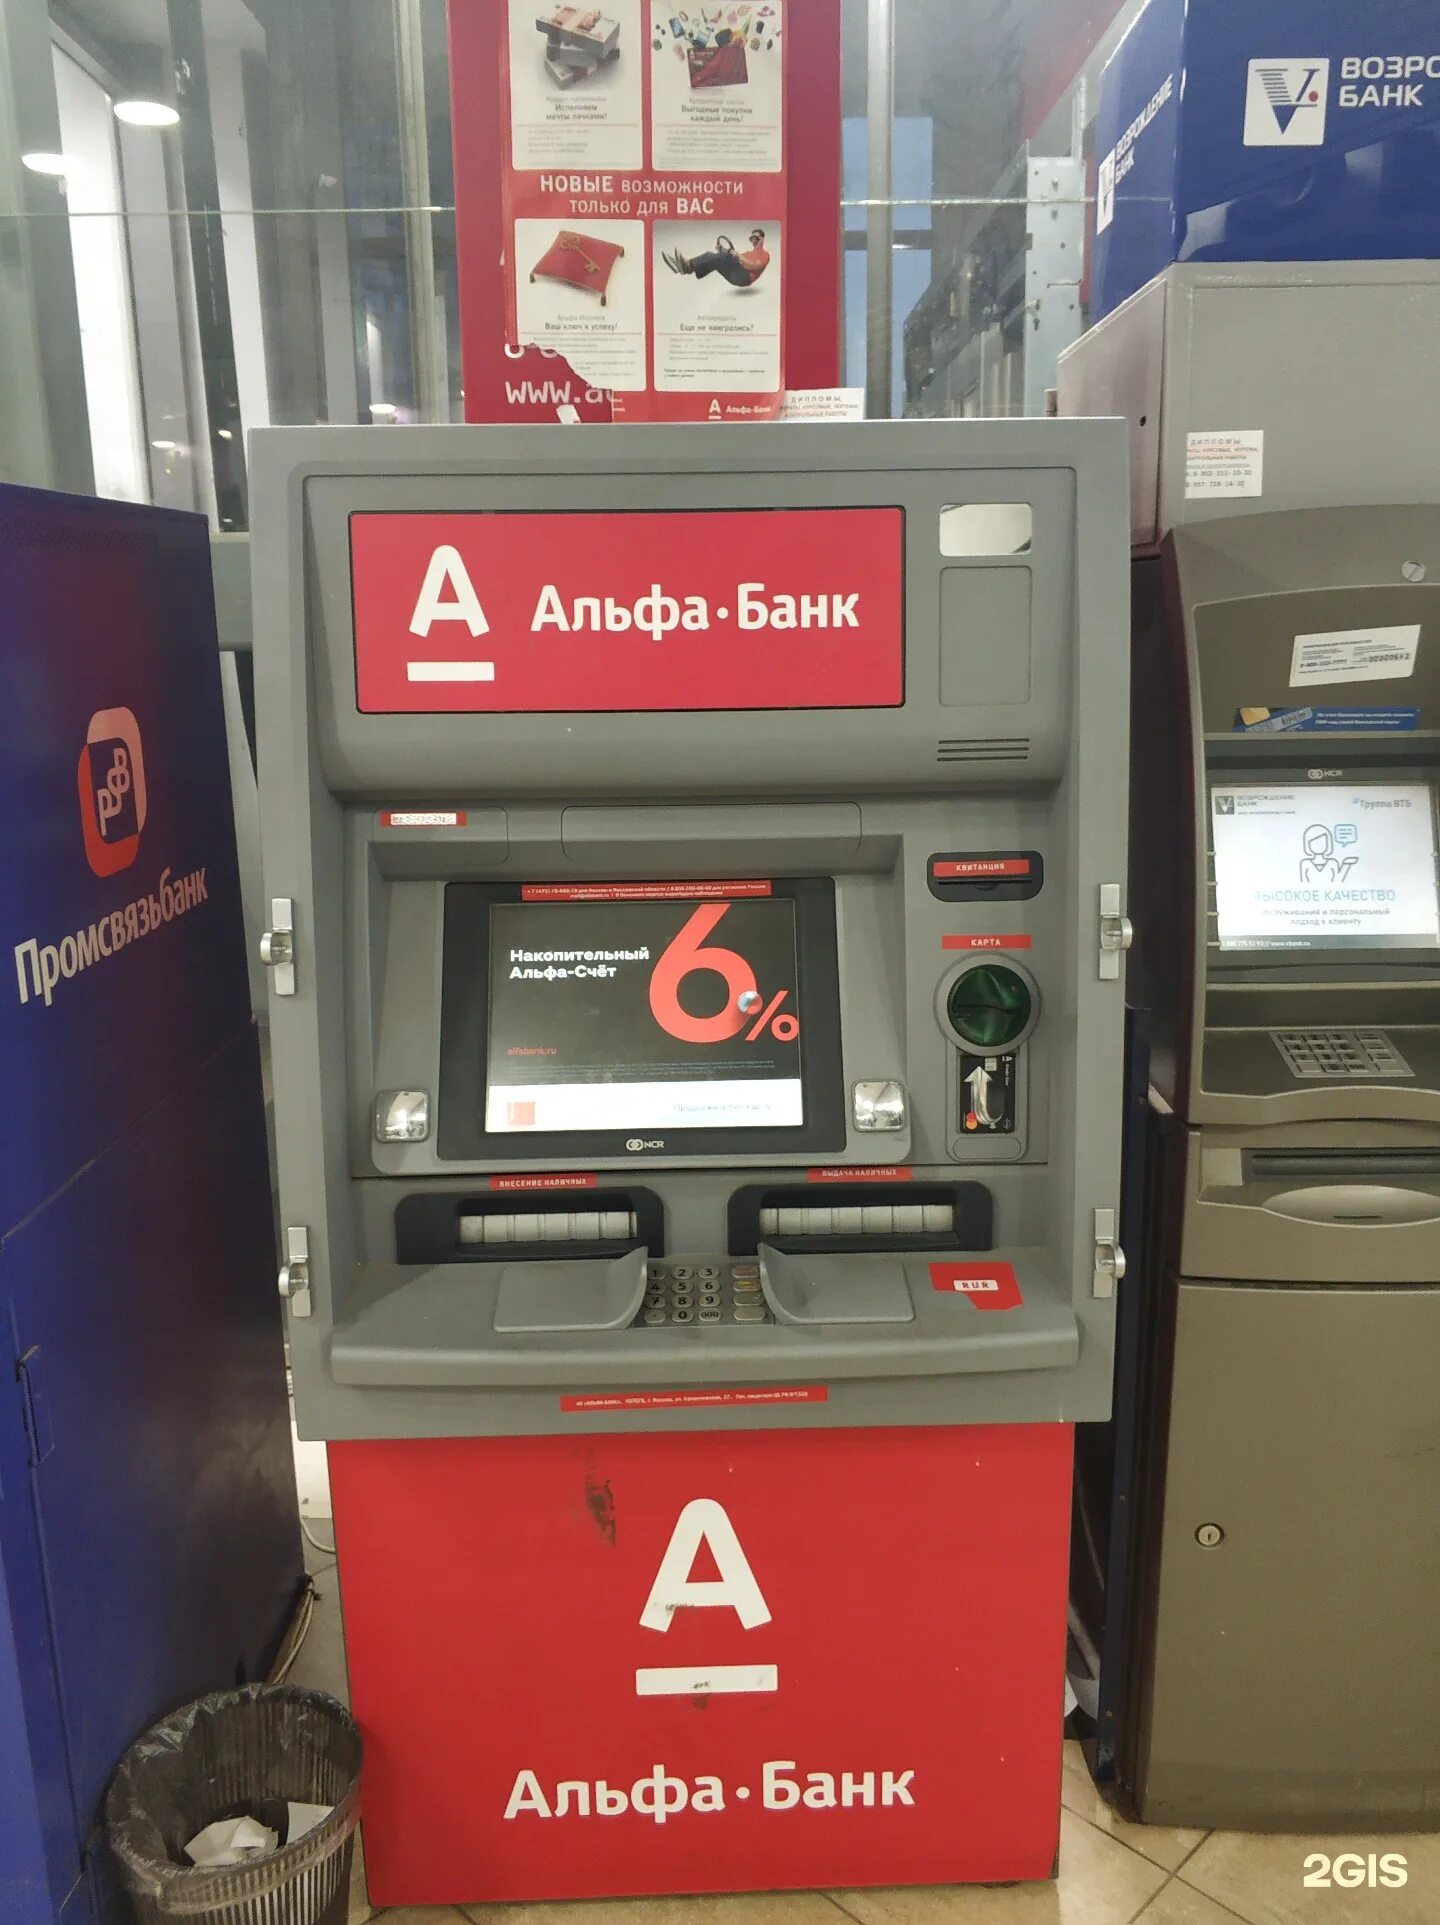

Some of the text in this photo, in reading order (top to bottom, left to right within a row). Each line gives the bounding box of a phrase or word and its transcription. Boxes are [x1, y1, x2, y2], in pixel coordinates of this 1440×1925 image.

[1338, 84, 1424, 107] БАНК
[540, 175, 614, 193] НОВЫЕ
[676, 197, 714, 215] ВАС
[545, 322, 561, 330] Ваш
[591, 322, 618, 332] успеху!
[409, 544, 490, 638] А
[1360, 799, 1412, 810] Группа ВТБ
[956, 862, 1005, 871] КВИТАНЦИЯ
[1325, 888, 1396, 901] КАЧЕСТВО
[1323, 908, 1328, 916] и
[1330, 907, 1390, 917] персональный
[14, 867, 208, 1006] Промсвязьбанк
[970, 938, 1001, 947] КАРТА
[510, 946, 650, 962] Накопительный
[509, 964, 617, 981] Альфа-Счёт
[643, 1140, 665, 1149] NCR
[822, 1168, 897, 1177] ВЫДАЧА НАЛИЧНЫХ
[499, 1178, 587, 1188] ВНЕСЕНИЕ НАЛИЧНЫХ
[652, 1268, 713, 1277] 1 2 3
[651, 1281, 713, 1291] 4 5 6
[962, 1281, 989, 1289] RUR
[678, 1297, 686, 1305] 8
[705, 1296, 714, 1304] 9
[678, 1311, 687, 1319] 0
[639, 1498, 772, 1632] А
